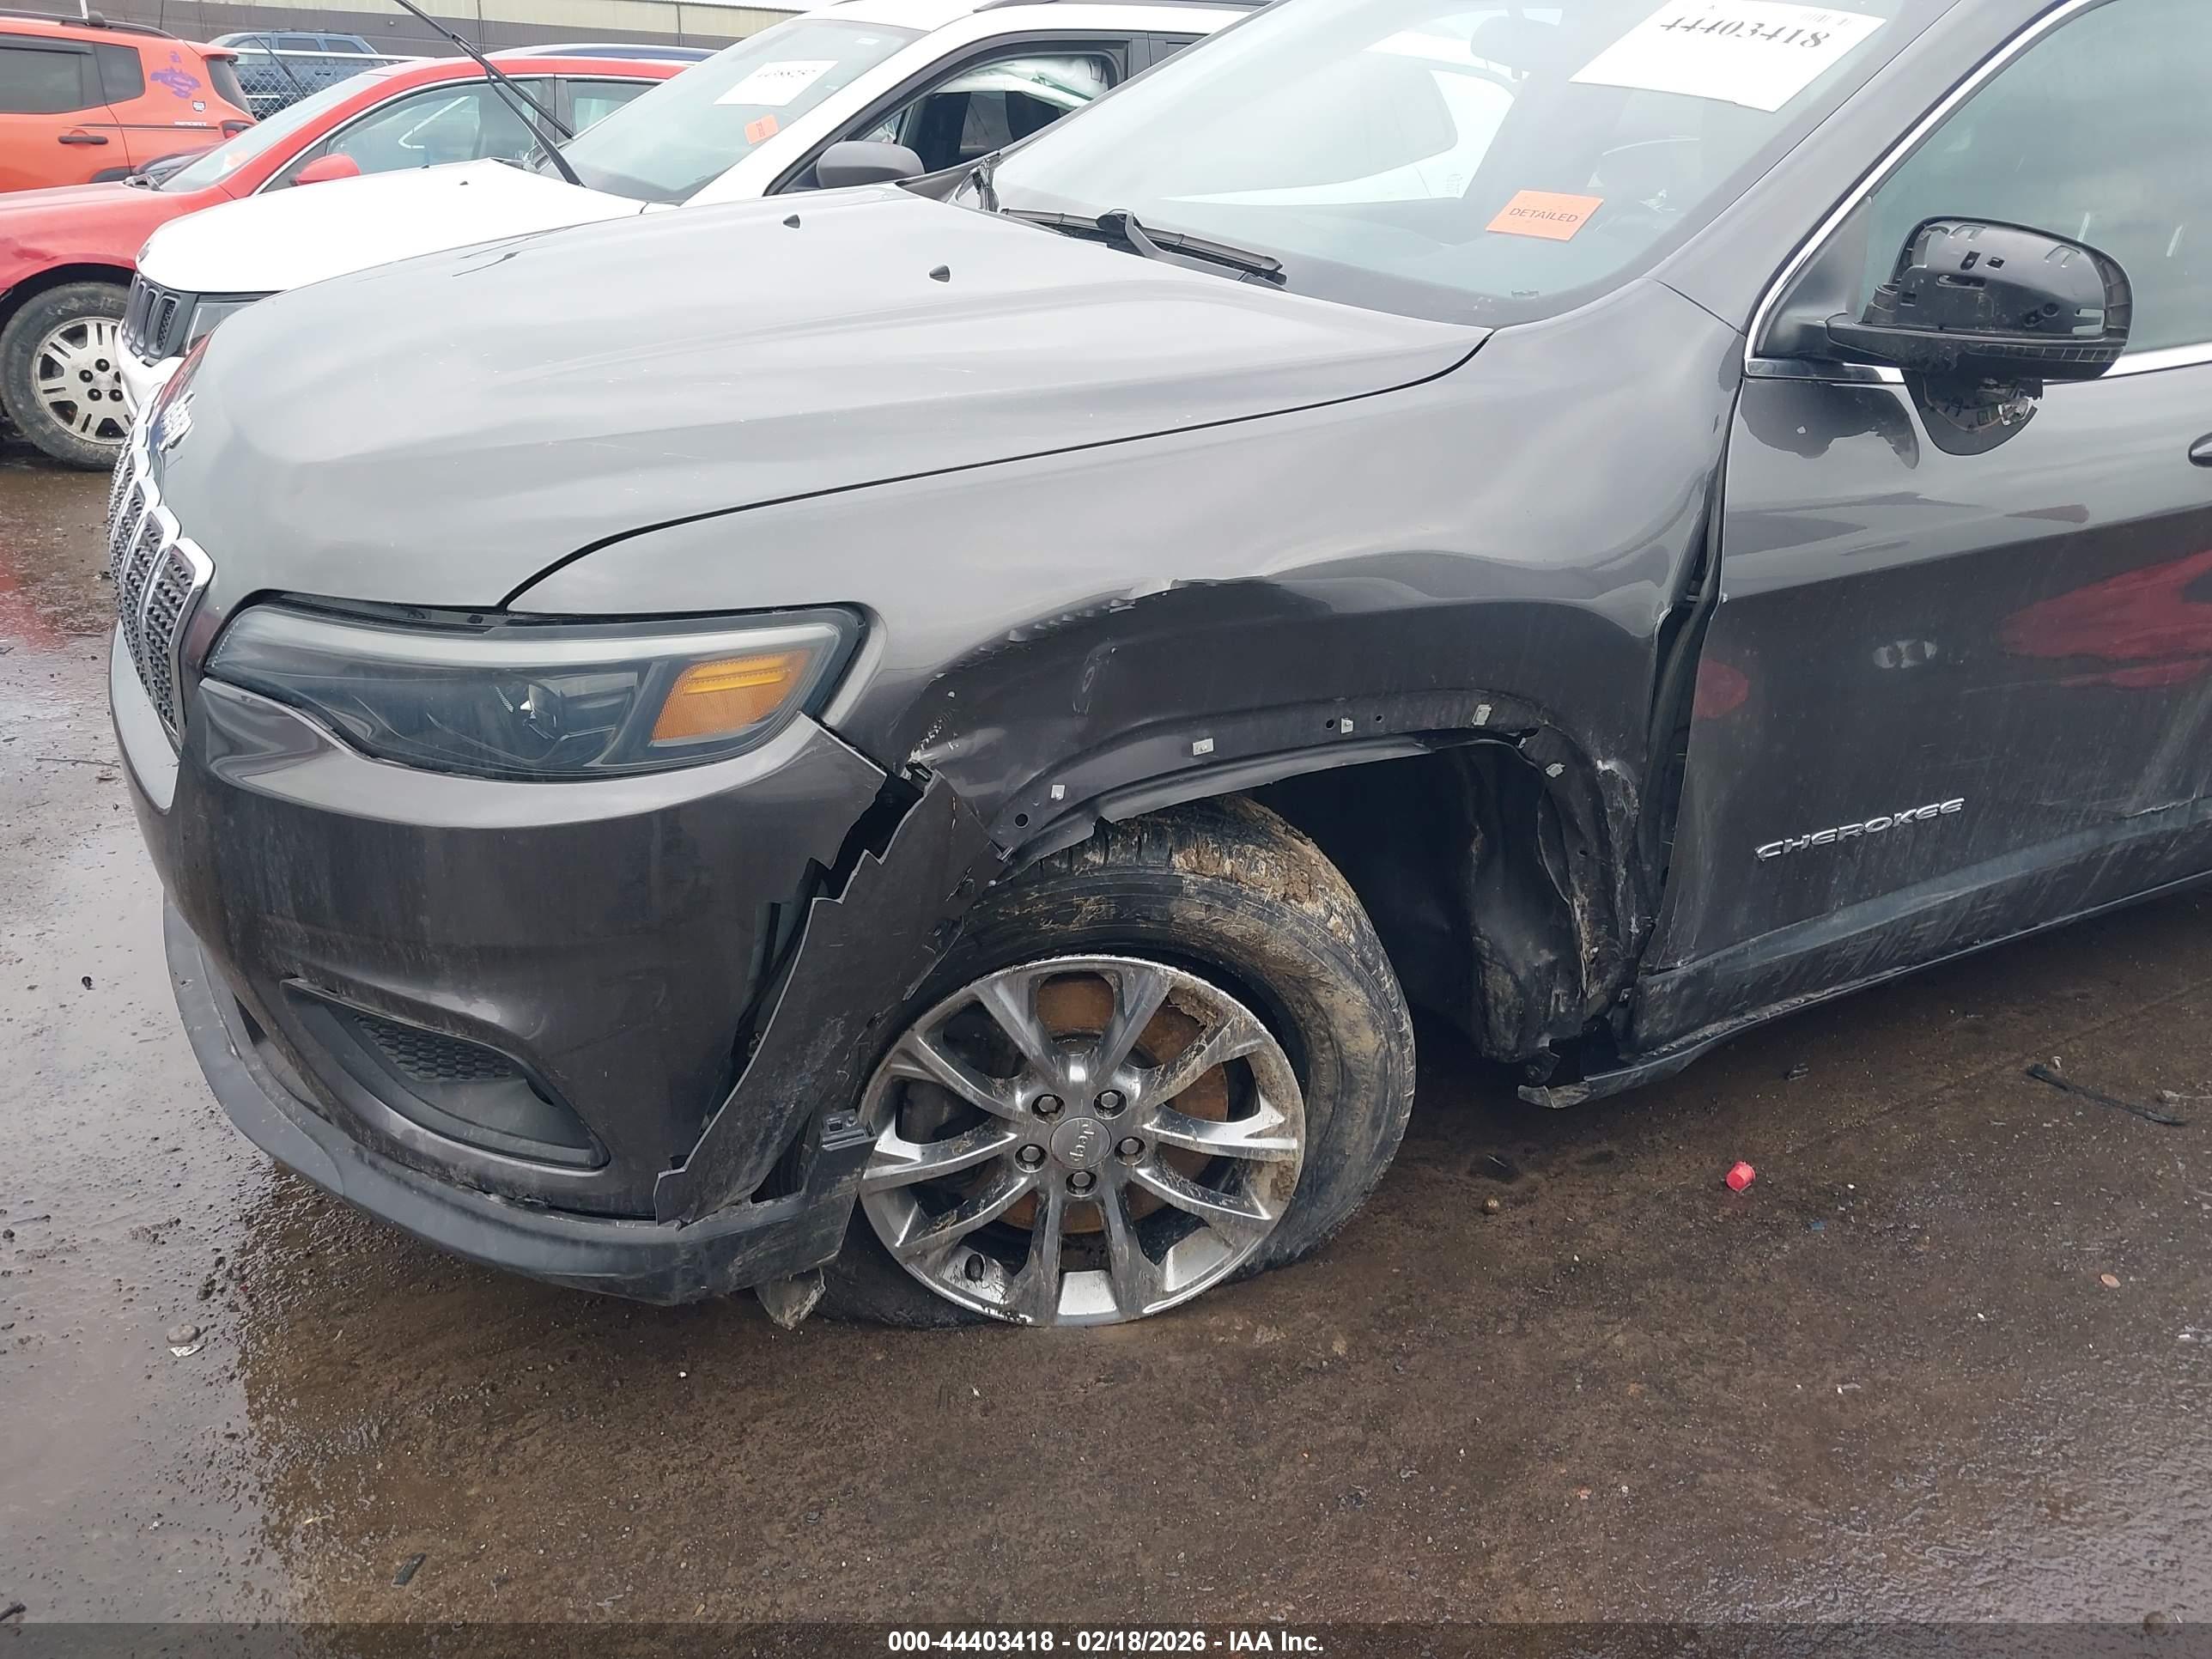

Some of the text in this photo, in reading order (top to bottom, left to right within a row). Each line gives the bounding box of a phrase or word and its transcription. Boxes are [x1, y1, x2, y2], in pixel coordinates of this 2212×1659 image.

[1660, 16, 1831, 48] 44403418
[1509, 207, 1579, 223] DETAILED
[1753, 796, 1966, 861] CHEROKEE
